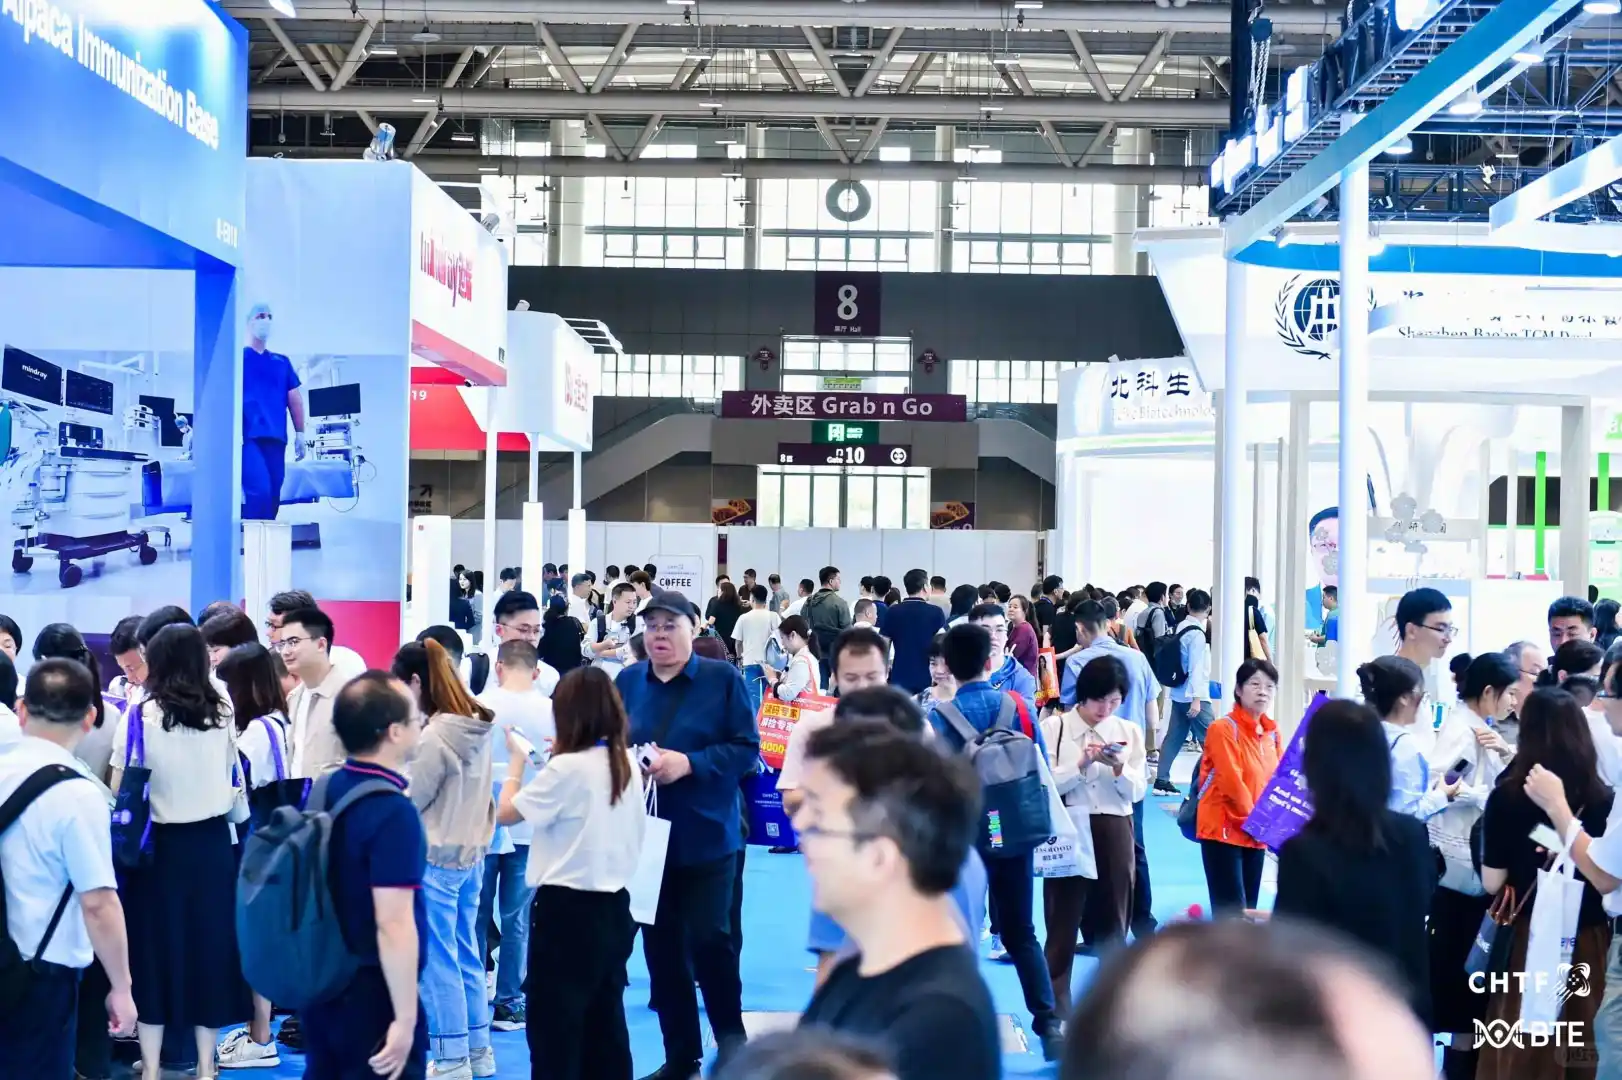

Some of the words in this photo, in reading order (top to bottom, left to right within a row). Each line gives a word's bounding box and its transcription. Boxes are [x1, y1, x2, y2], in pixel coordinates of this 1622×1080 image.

[77, 13, 184, 128] Immunization
[186, 88, 219, 150] Base
[837, 284, 858, 320] 8
[22, 364, 48, 380] mindray
[1110, 370, 1191, 400] 北科生
[751, 394, 816, 416] 外卖区
[822, 396, 876, 415] Grab
[883, 401, 896, 415] n
[902, 398, 933, 416] Go
[845, 446, 865, 464] 10
[660, 578, 691, 587] COFFEE
